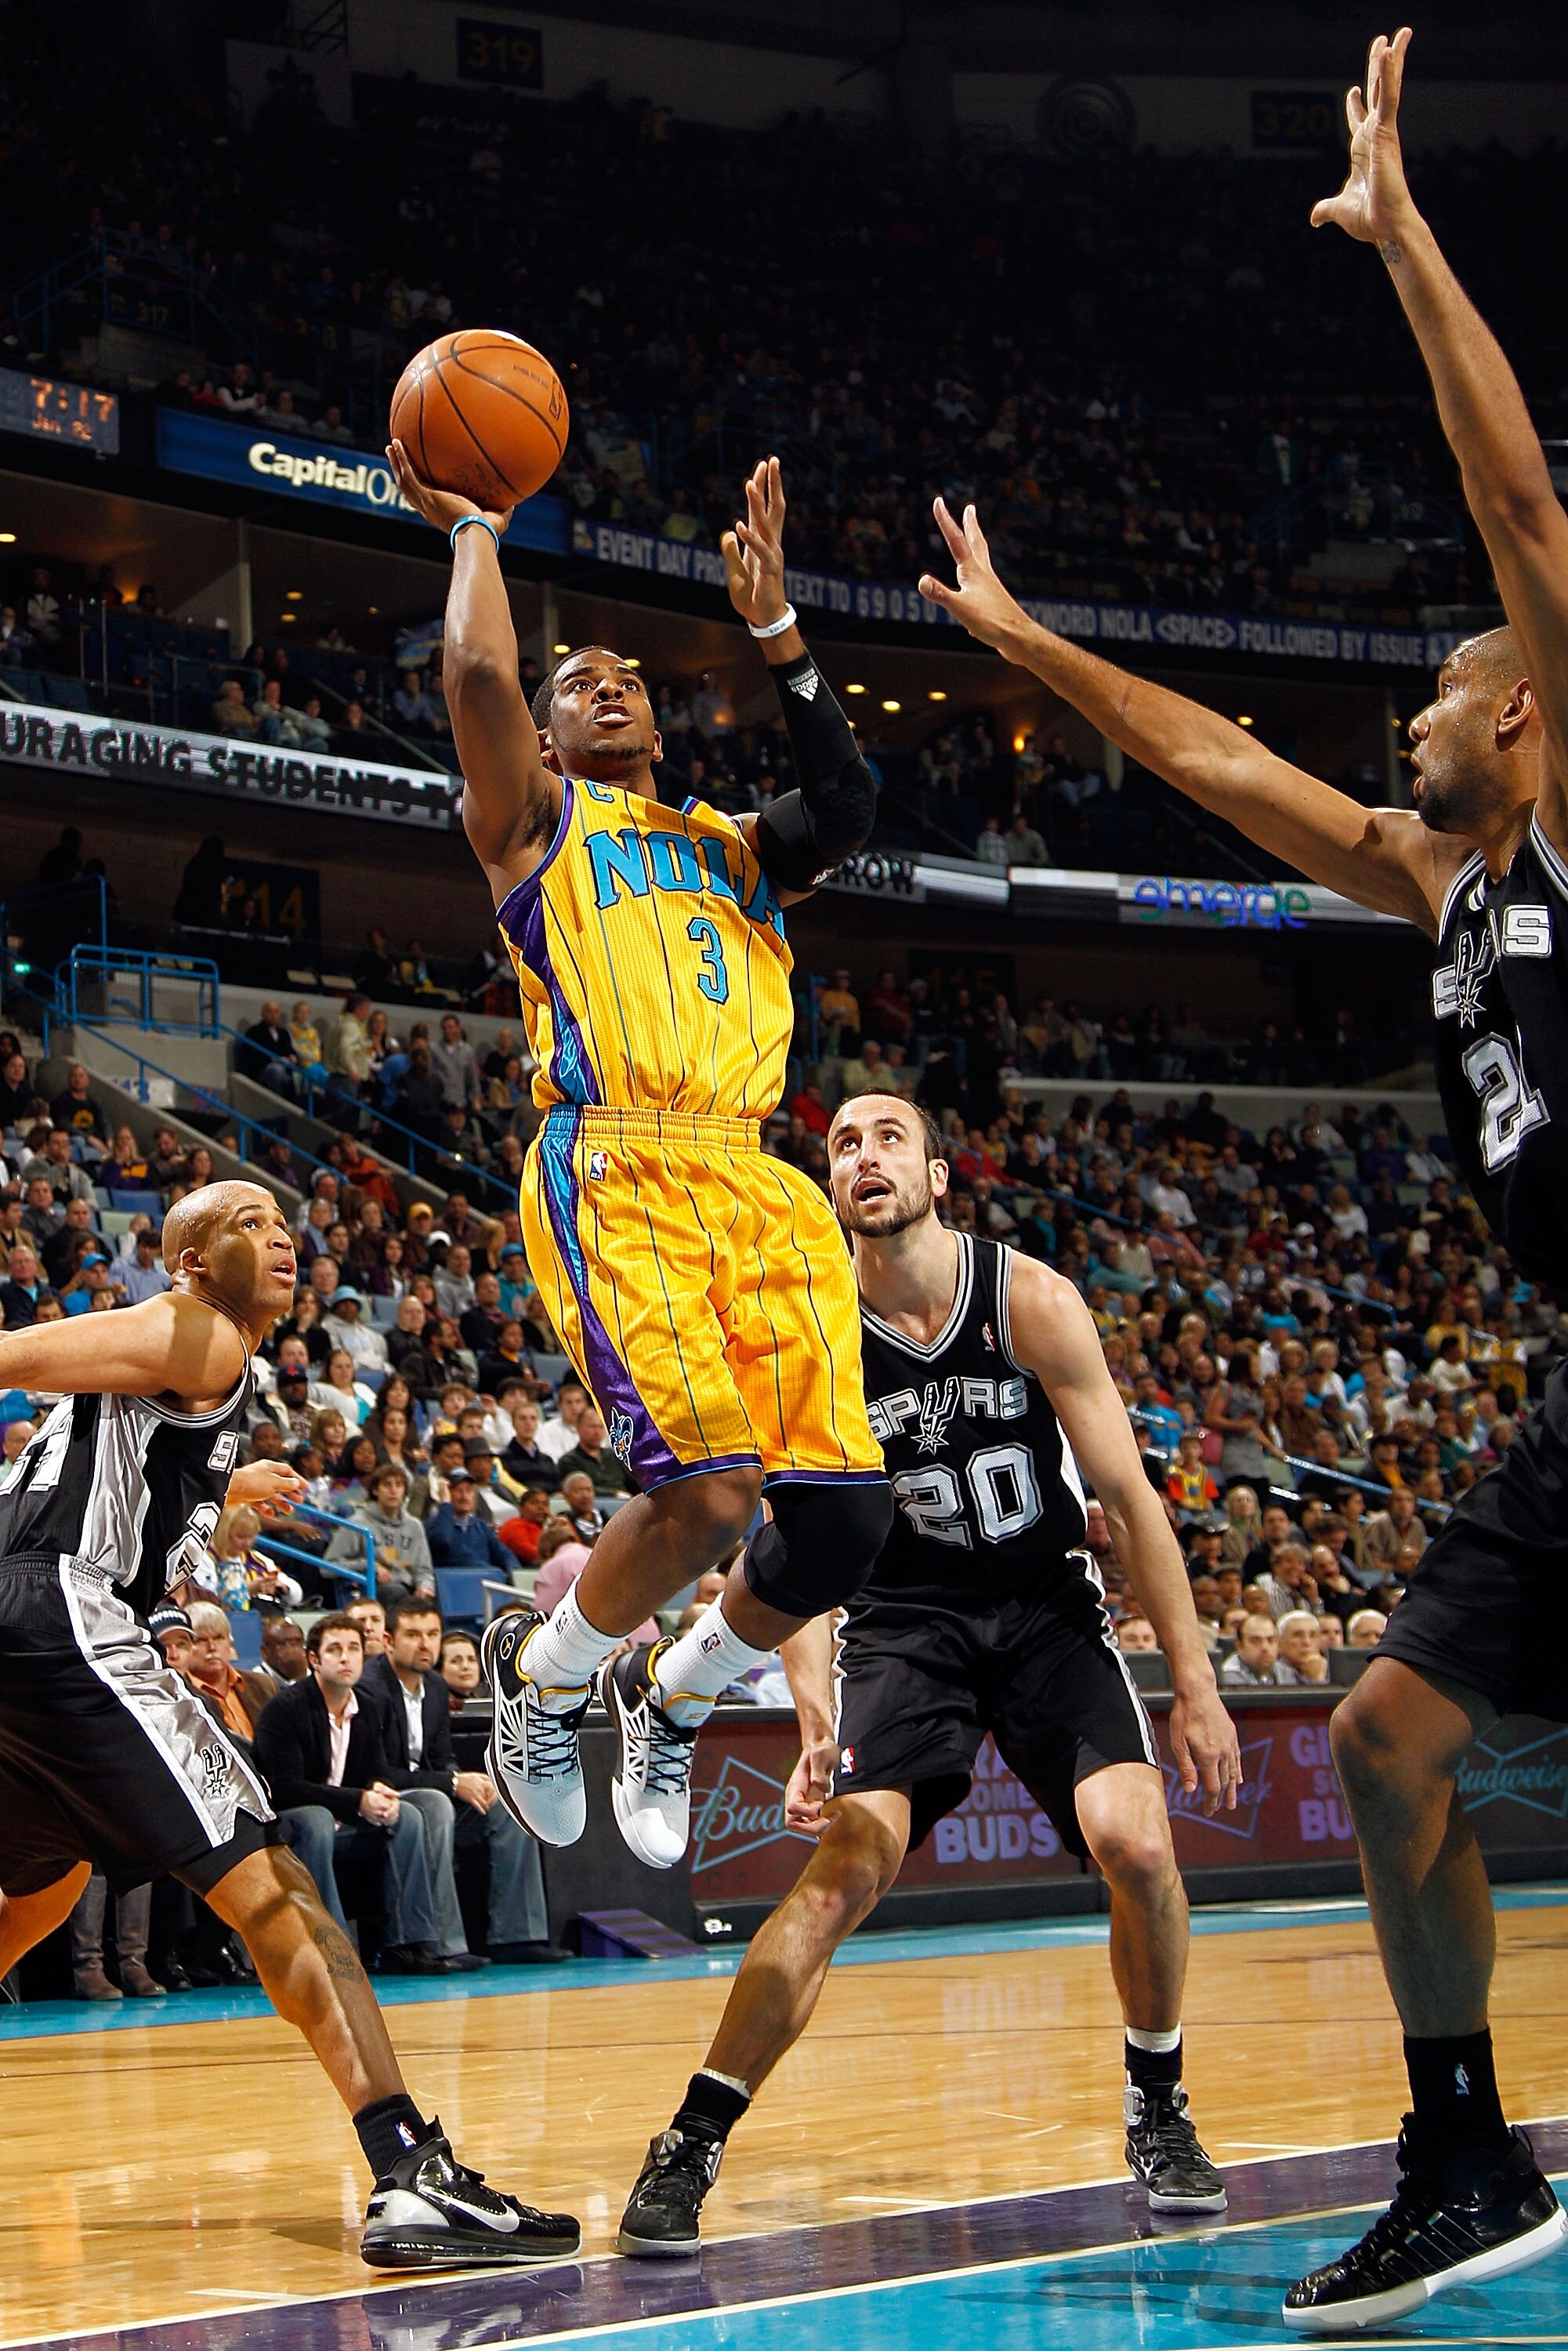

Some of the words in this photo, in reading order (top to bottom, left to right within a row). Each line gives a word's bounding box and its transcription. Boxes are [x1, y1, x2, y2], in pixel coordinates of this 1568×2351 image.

[466, 31, 537, 73] 319
[1255, 102, 1332, 136] 320
[30, 377, 115, 422] 7:17
[596, 526, 655, 571] EVENT
[656, 539, 691, 579] DAY
[1099, 606, 1154, 642] NOLA
[1238, 620, 1338, 659] FOLLOWED
[1338, 629, 1367, 662] BY
[581, 828, 786, 944] NOLA
[686, 916, 730, 1005] 3
[866, 1376, 1030, 1456] SPURS
[891, 1442, 1044, 1550] 20
[934, 1812, 1059, 1864] BUDS
